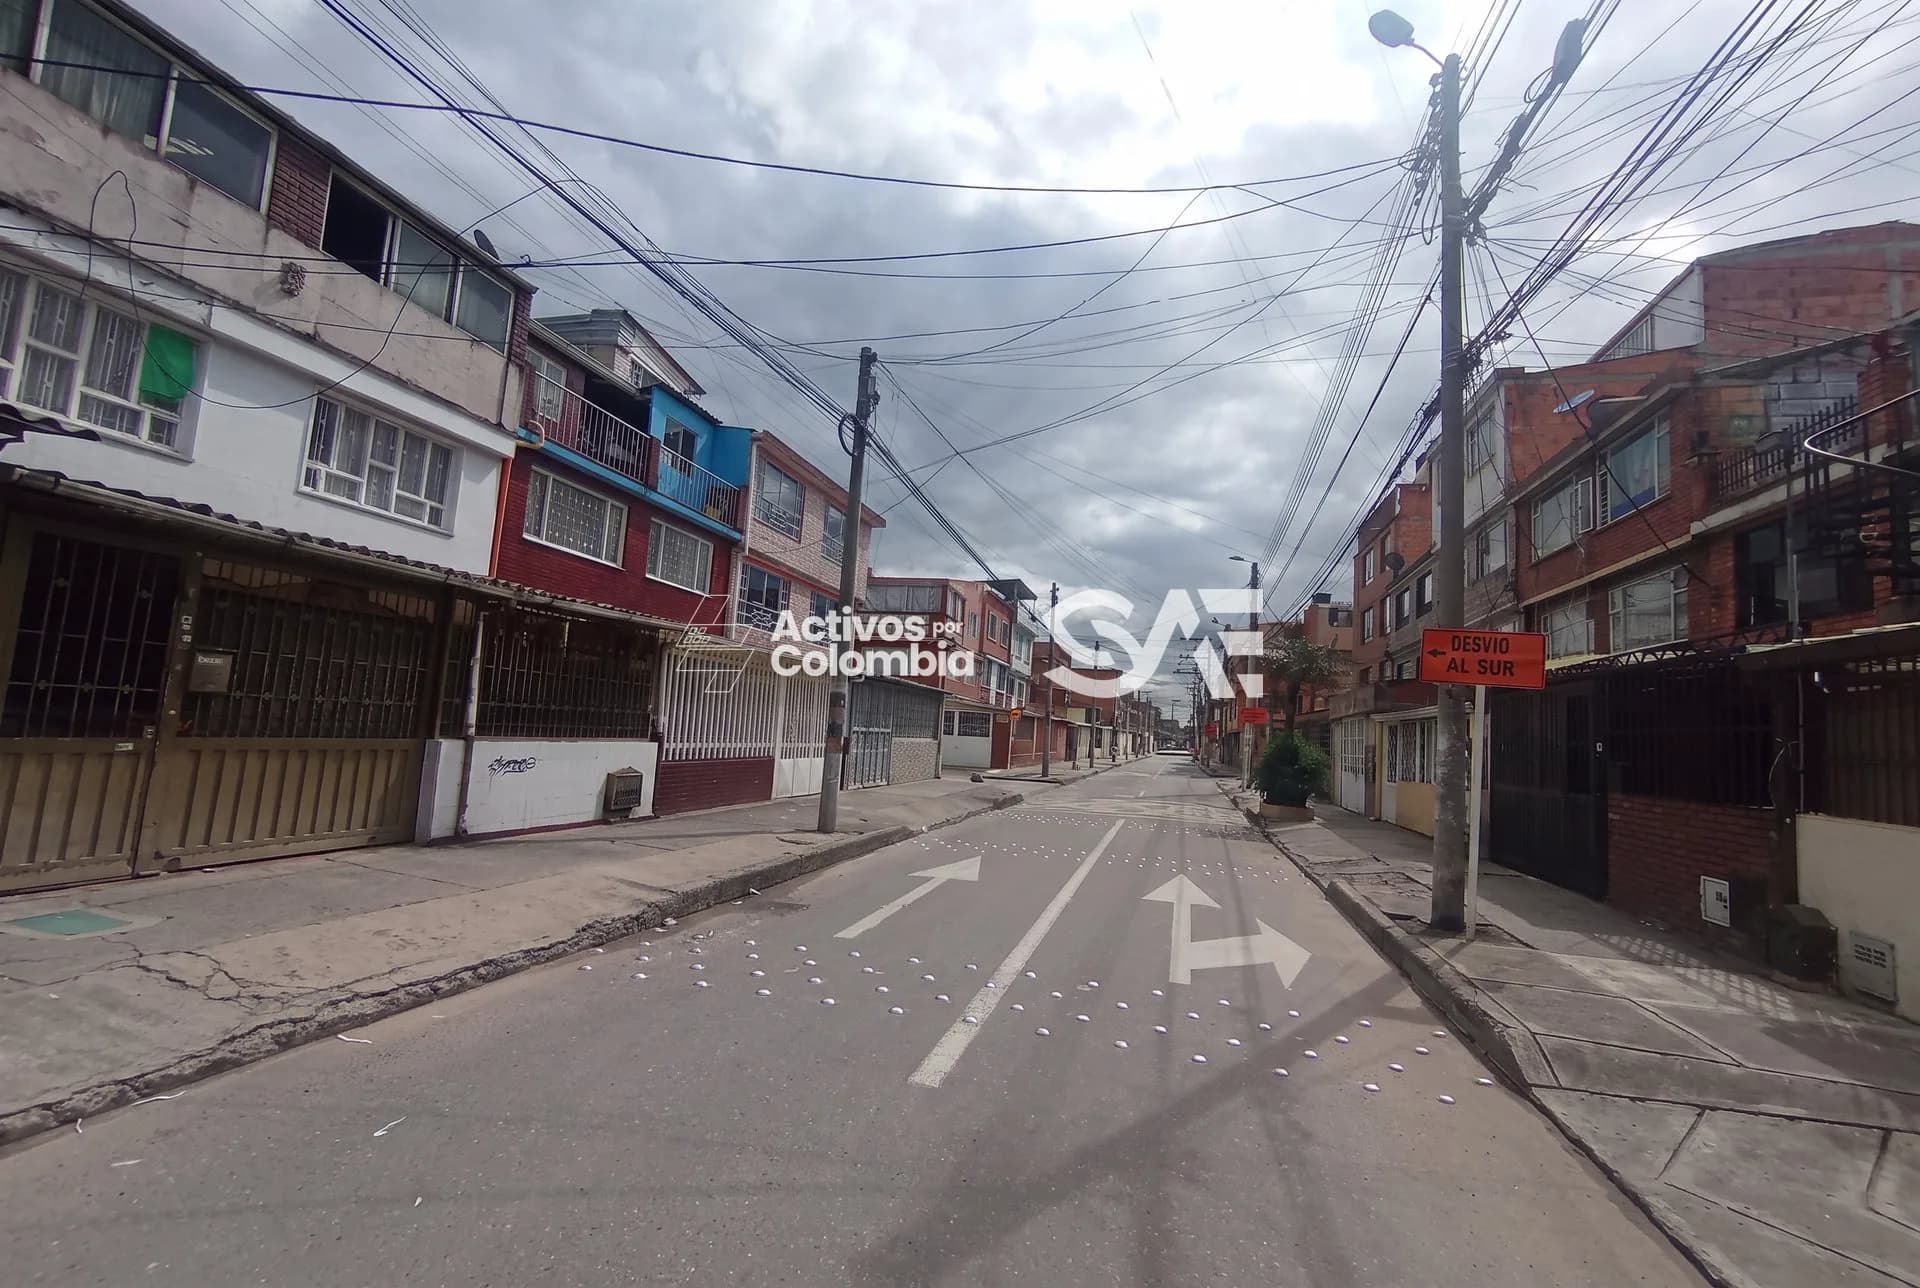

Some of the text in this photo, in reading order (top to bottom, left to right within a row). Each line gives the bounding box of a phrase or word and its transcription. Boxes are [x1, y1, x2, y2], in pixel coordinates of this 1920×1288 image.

[1451, 635, 1510, 655] DESVIO
[1446, 657, 1515, 677] AL SUR
